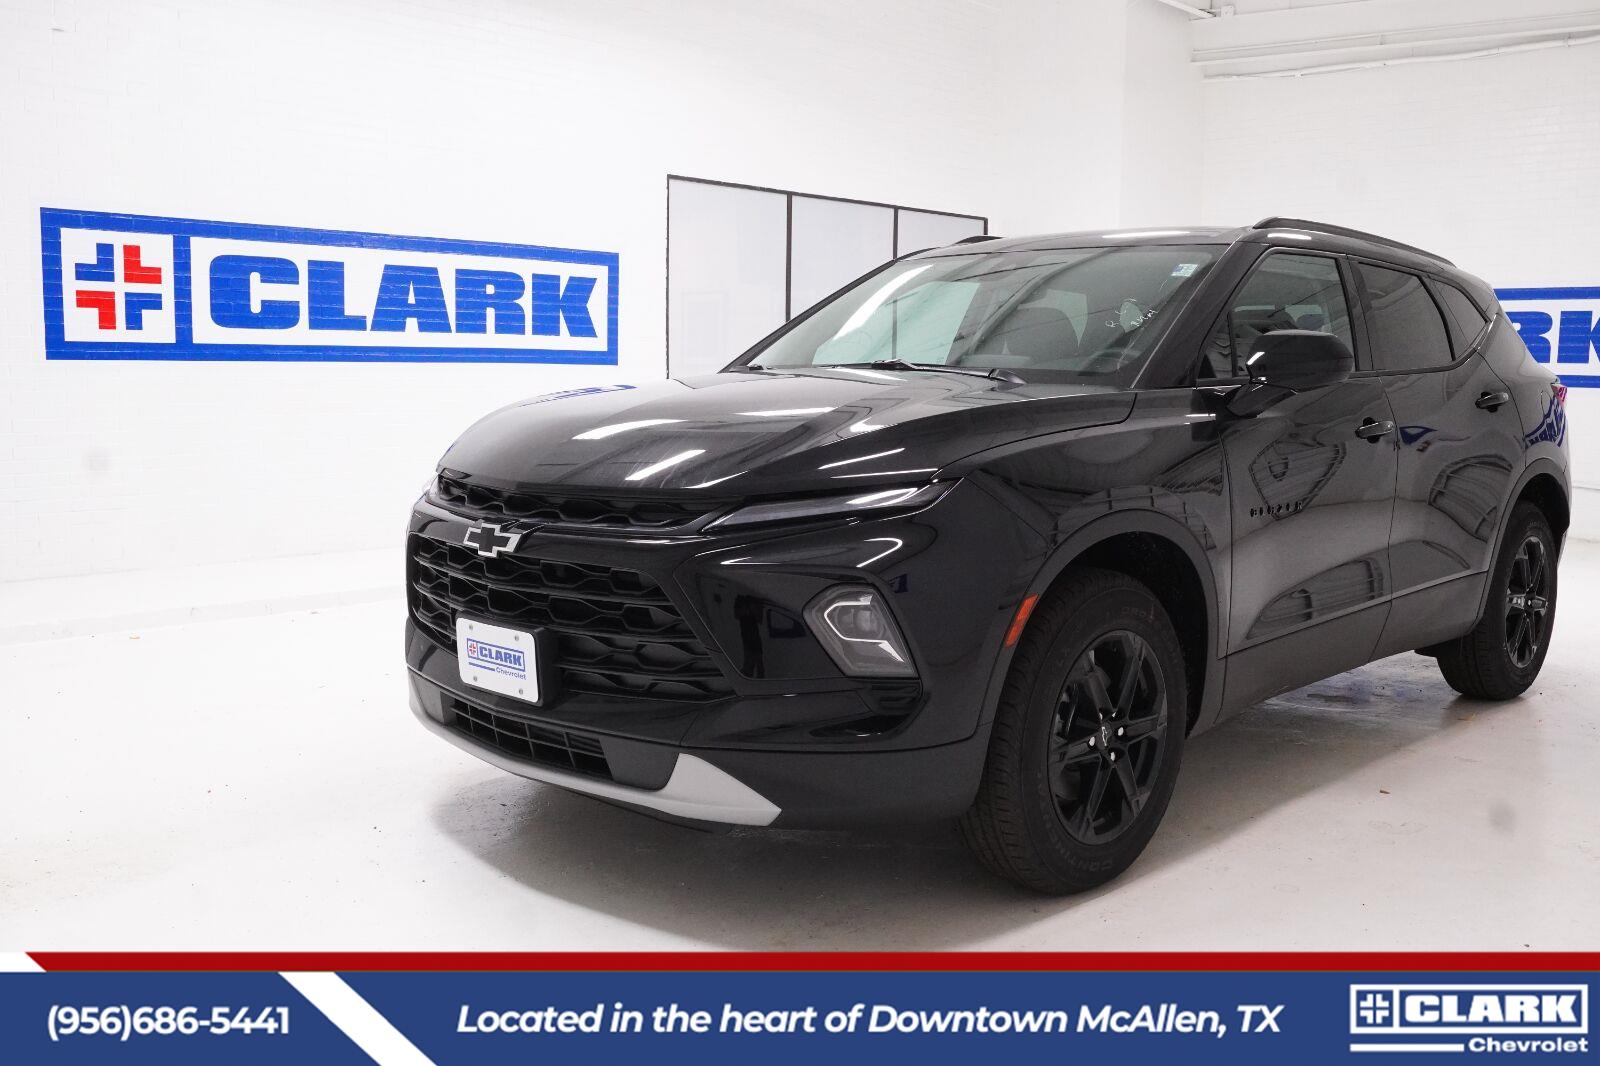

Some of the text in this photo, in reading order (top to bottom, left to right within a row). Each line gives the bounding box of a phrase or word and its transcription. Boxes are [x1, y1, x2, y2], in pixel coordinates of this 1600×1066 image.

[209, 254, 598, 338] CLARK
[479, 645, 522, 667] CLARK
[496, 667, 526, 680] Chevrolet
